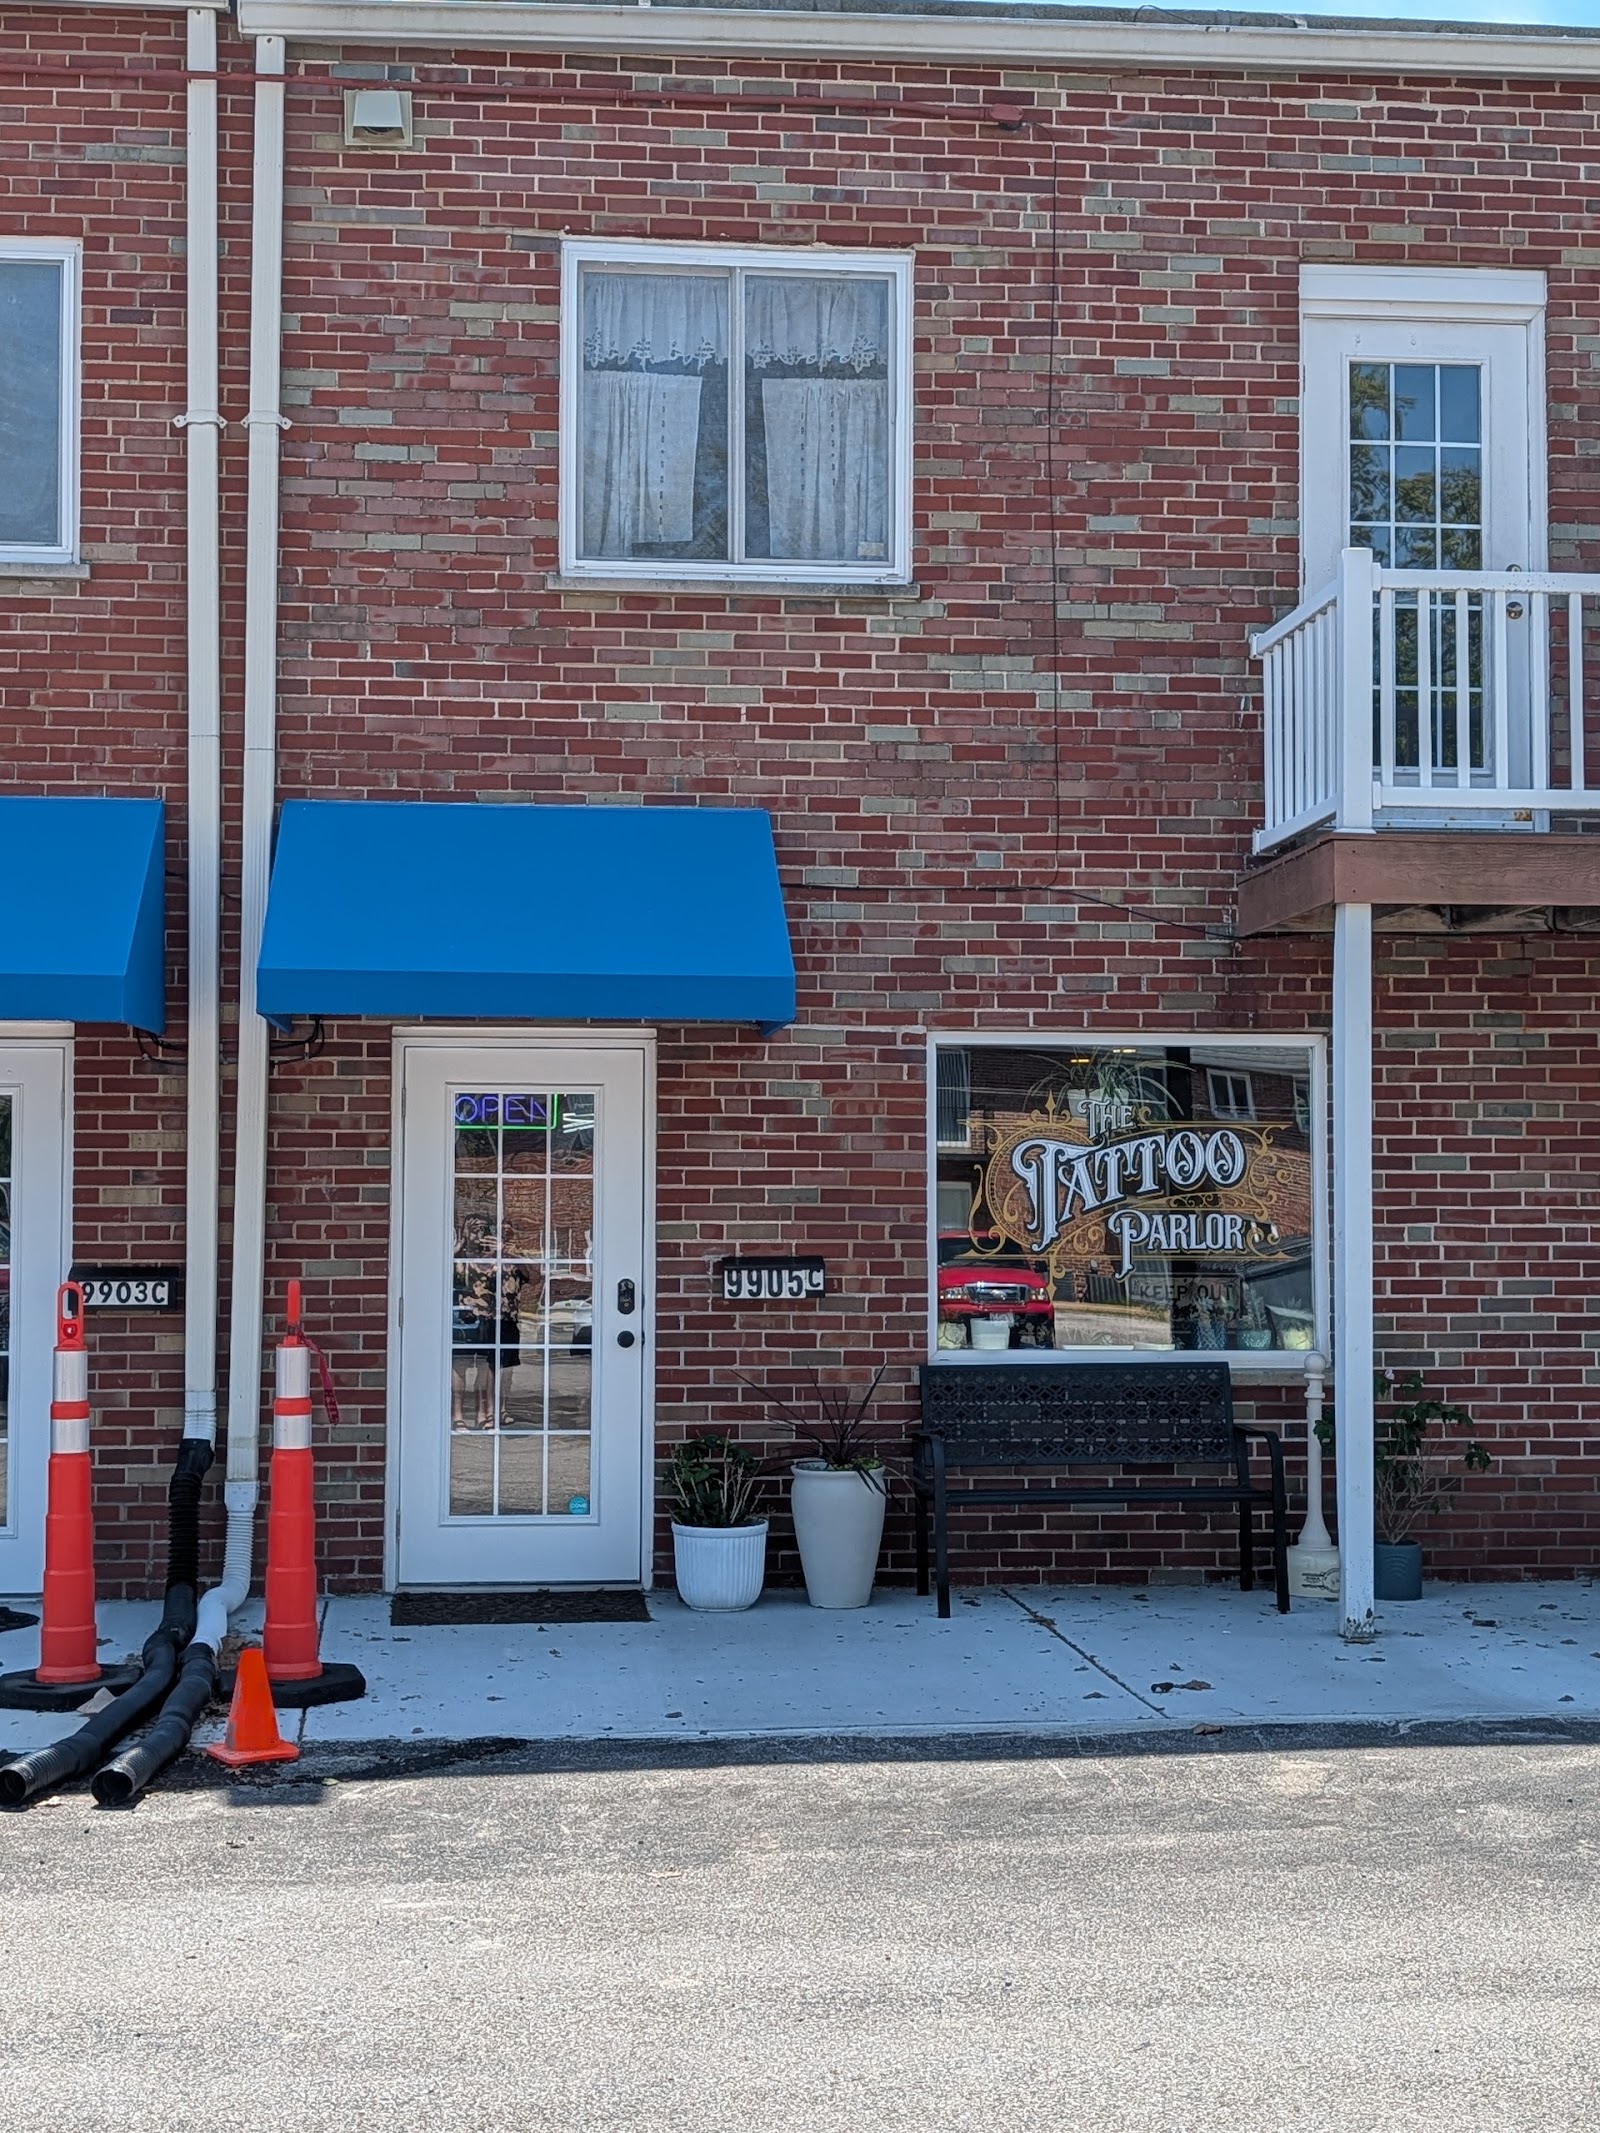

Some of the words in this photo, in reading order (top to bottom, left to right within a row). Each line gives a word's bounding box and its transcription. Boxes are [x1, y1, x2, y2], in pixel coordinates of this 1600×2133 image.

[455, 1095, 547, 1124] OPEN
[1077, 1098, 1137, 1140] THE
[1011, 1129, 1246, 1252] TATTOO
[1107, 1208, 1247, 1281] PARLOR
[82, 1281, 166, 1304] 9903C
[726, 1268, 822, 1298] 9905C
[1139, 1285, 1188, 1299] KEEP
[1197, 1284, 1234, 1301] OUT
